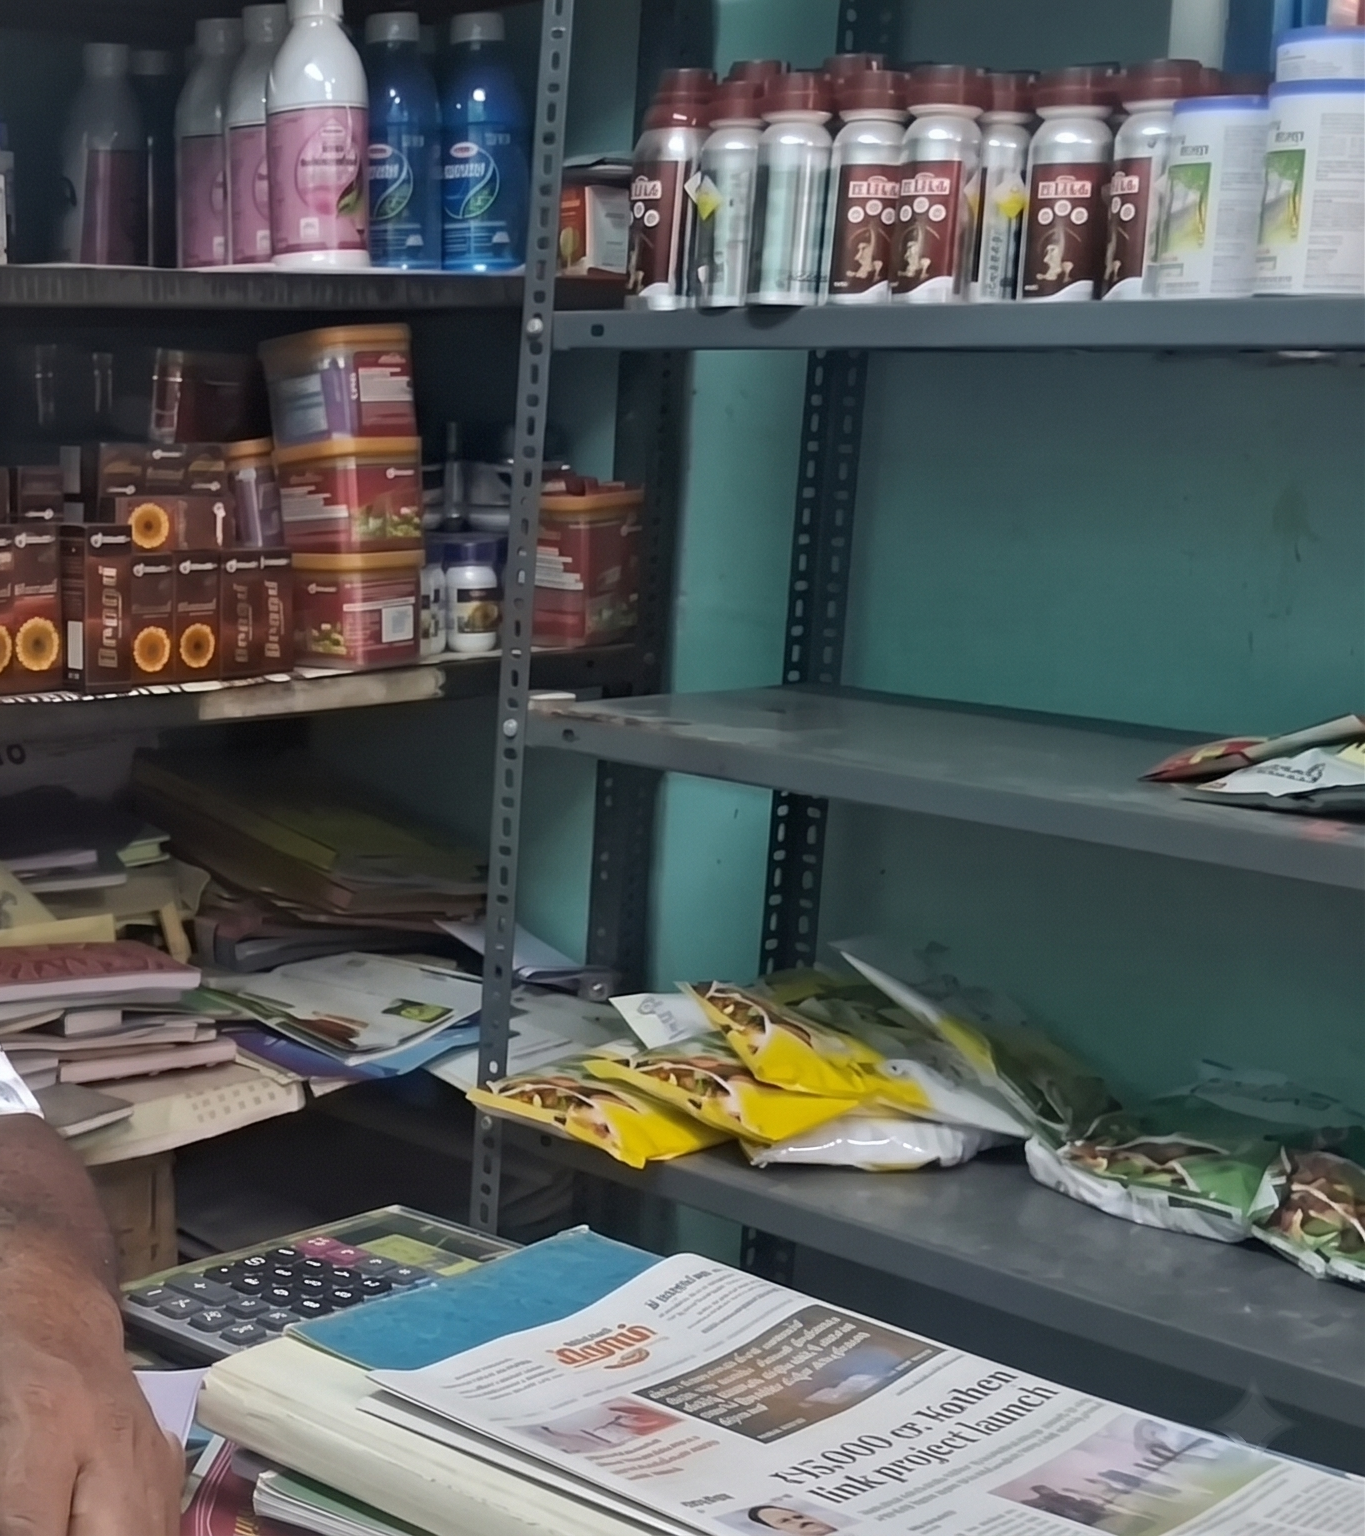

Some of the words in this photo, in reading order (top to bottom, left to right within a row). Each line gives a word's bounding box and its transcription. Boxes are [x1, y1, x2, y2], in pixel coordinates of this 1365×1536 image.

[806, 1470, 888, 1504] link
[873, 1428, 980, 1484] project
[956, 1384, 1060, 1437] launch
